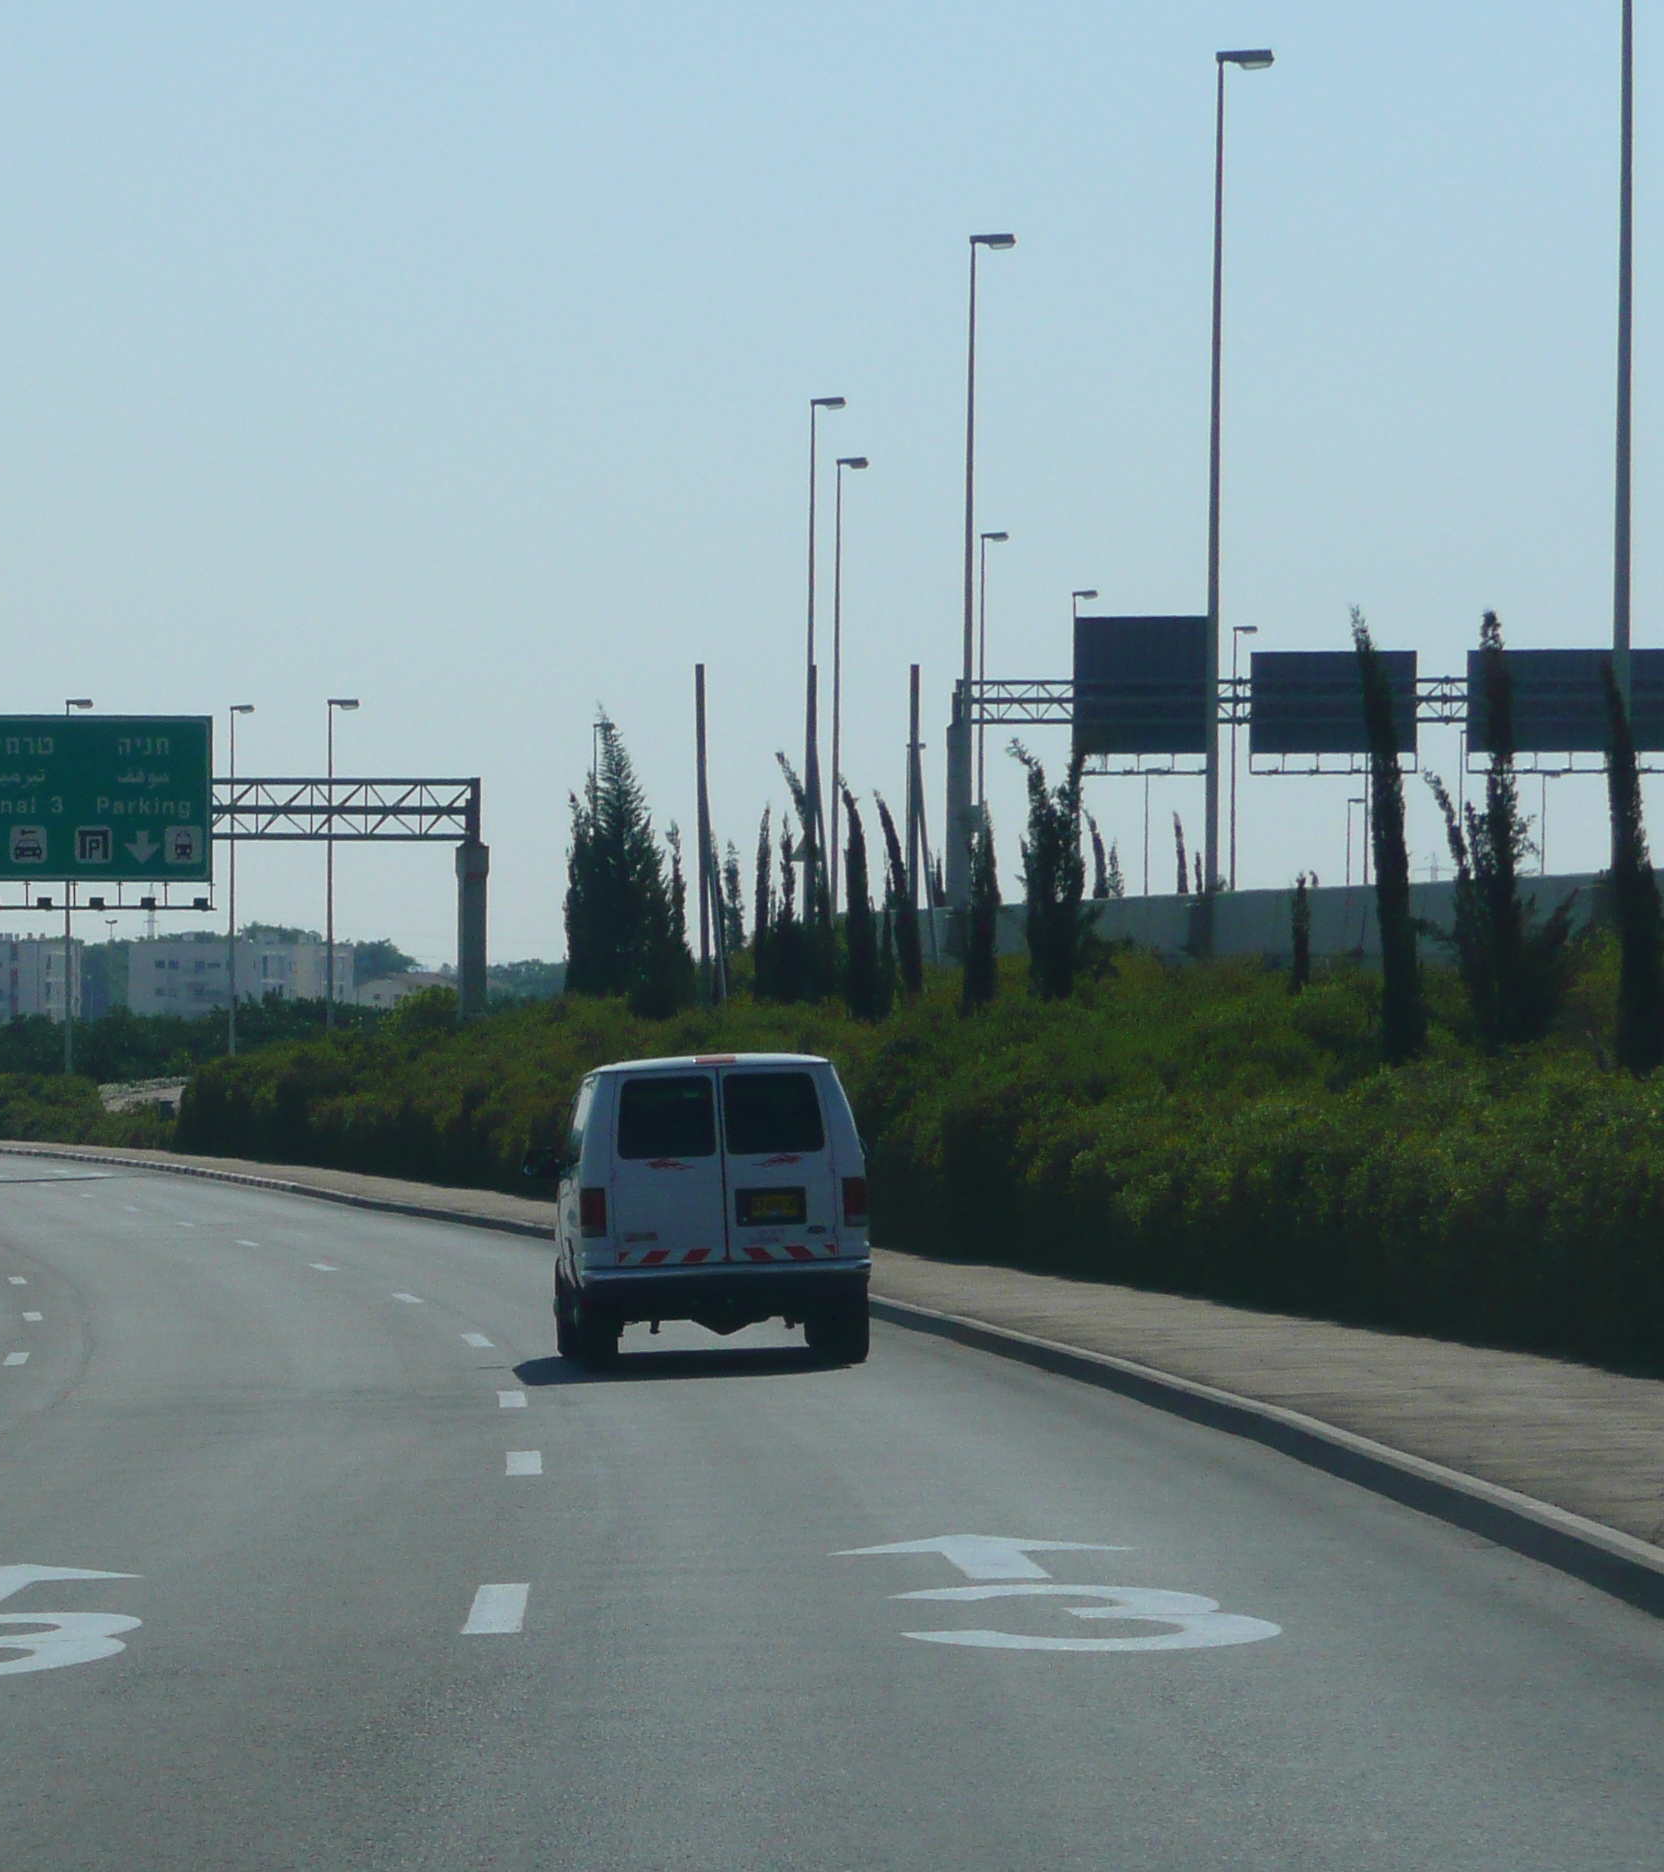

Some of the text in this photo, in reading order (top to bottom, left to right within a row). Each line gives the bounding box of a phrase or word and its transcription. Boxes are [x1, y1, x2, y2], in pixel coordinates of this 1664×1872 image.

[117, 737, 170, 756] חניה
[116, 767, 170, 789] موقف
[50, 796, 64, 814] 3
[96, 796, 191, 819] Parking
[887, 1583, 1283, 1651] 3
